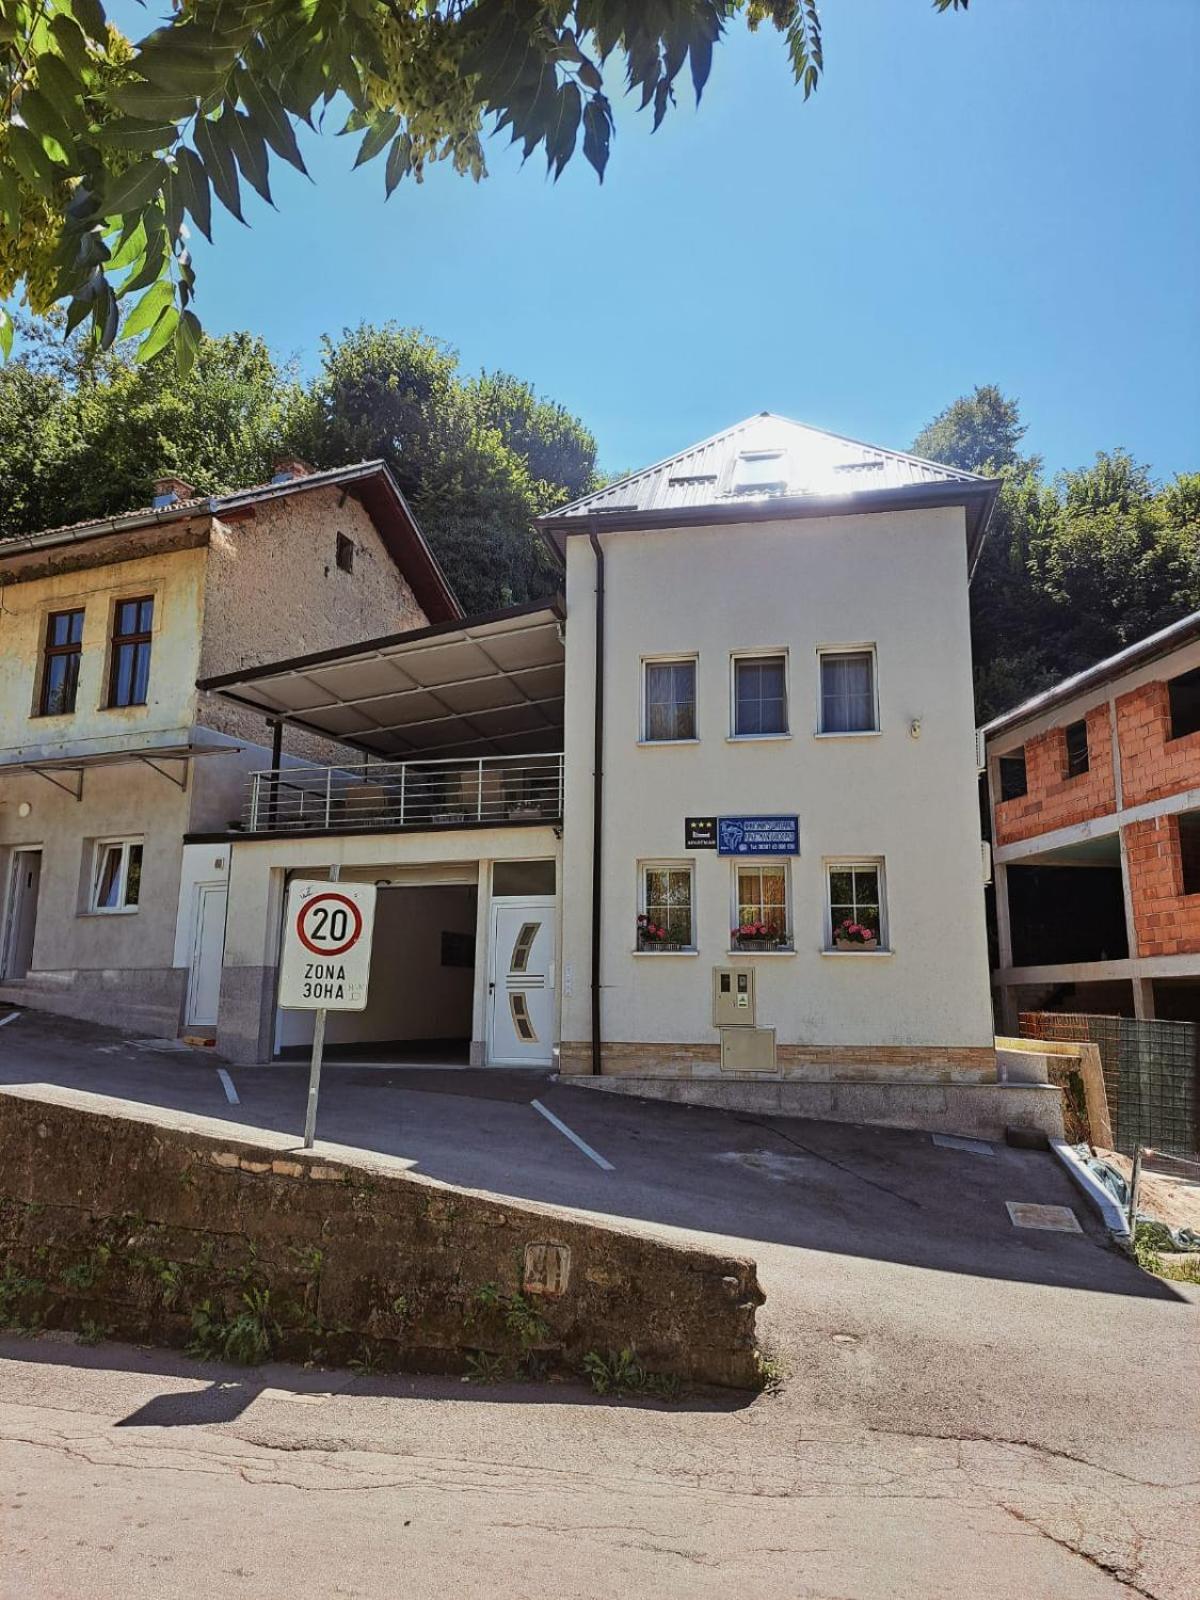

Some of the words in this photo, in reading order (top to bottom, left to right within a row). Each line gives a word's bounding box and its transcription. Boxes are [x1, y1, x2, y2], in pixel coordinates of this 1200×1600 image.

[311, 908, 347, 941] 20
[304, 963, 345, 980] ZONA
[303, 983, 344, 999] ЗОНА
